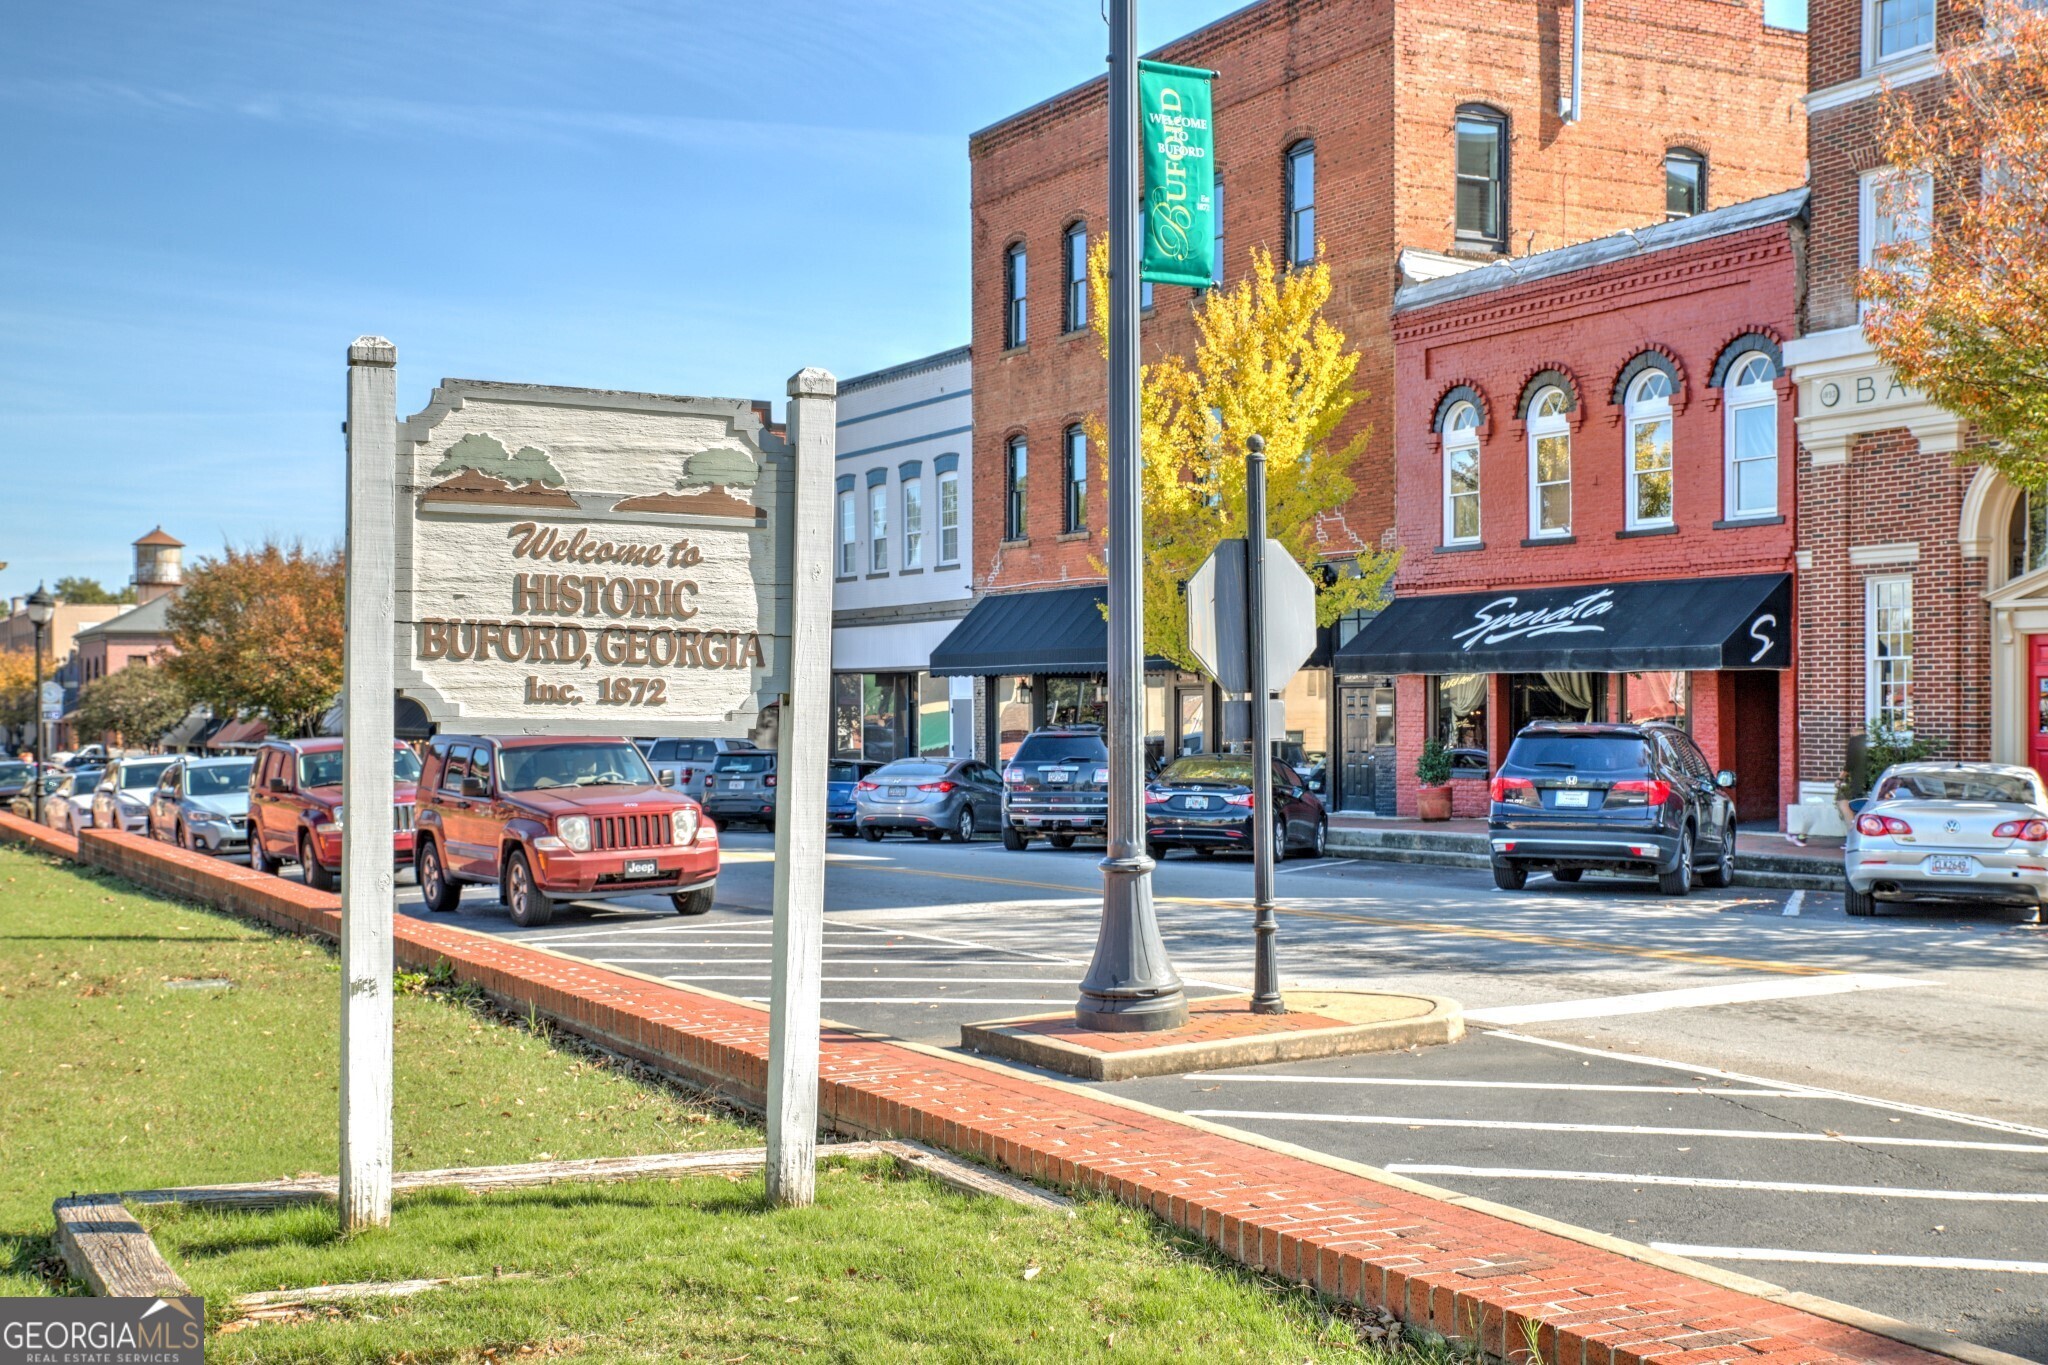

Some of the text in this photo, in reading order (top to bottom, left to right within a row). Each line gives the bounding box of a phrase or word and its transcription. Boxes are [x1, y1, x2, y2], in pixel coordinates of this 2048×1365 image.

[1149, 113, 1207, 130] WELCOME
[1172, 130, 1189, 142] TO
[1157, 142, 1205, 158] BUFORD
[508, 522, 704, 566] Welcome to
[515, 573, 700, 618] HISTORIC
[1452, 588, 1615, 652] Sperata
[420, 617, 766, 668] BUFORD, GEORGIA
[1750, 614, 1776, 663] S
[526, 675, 667, 704] Inc. 1872
[628, 862, 655, 874] Jeep
